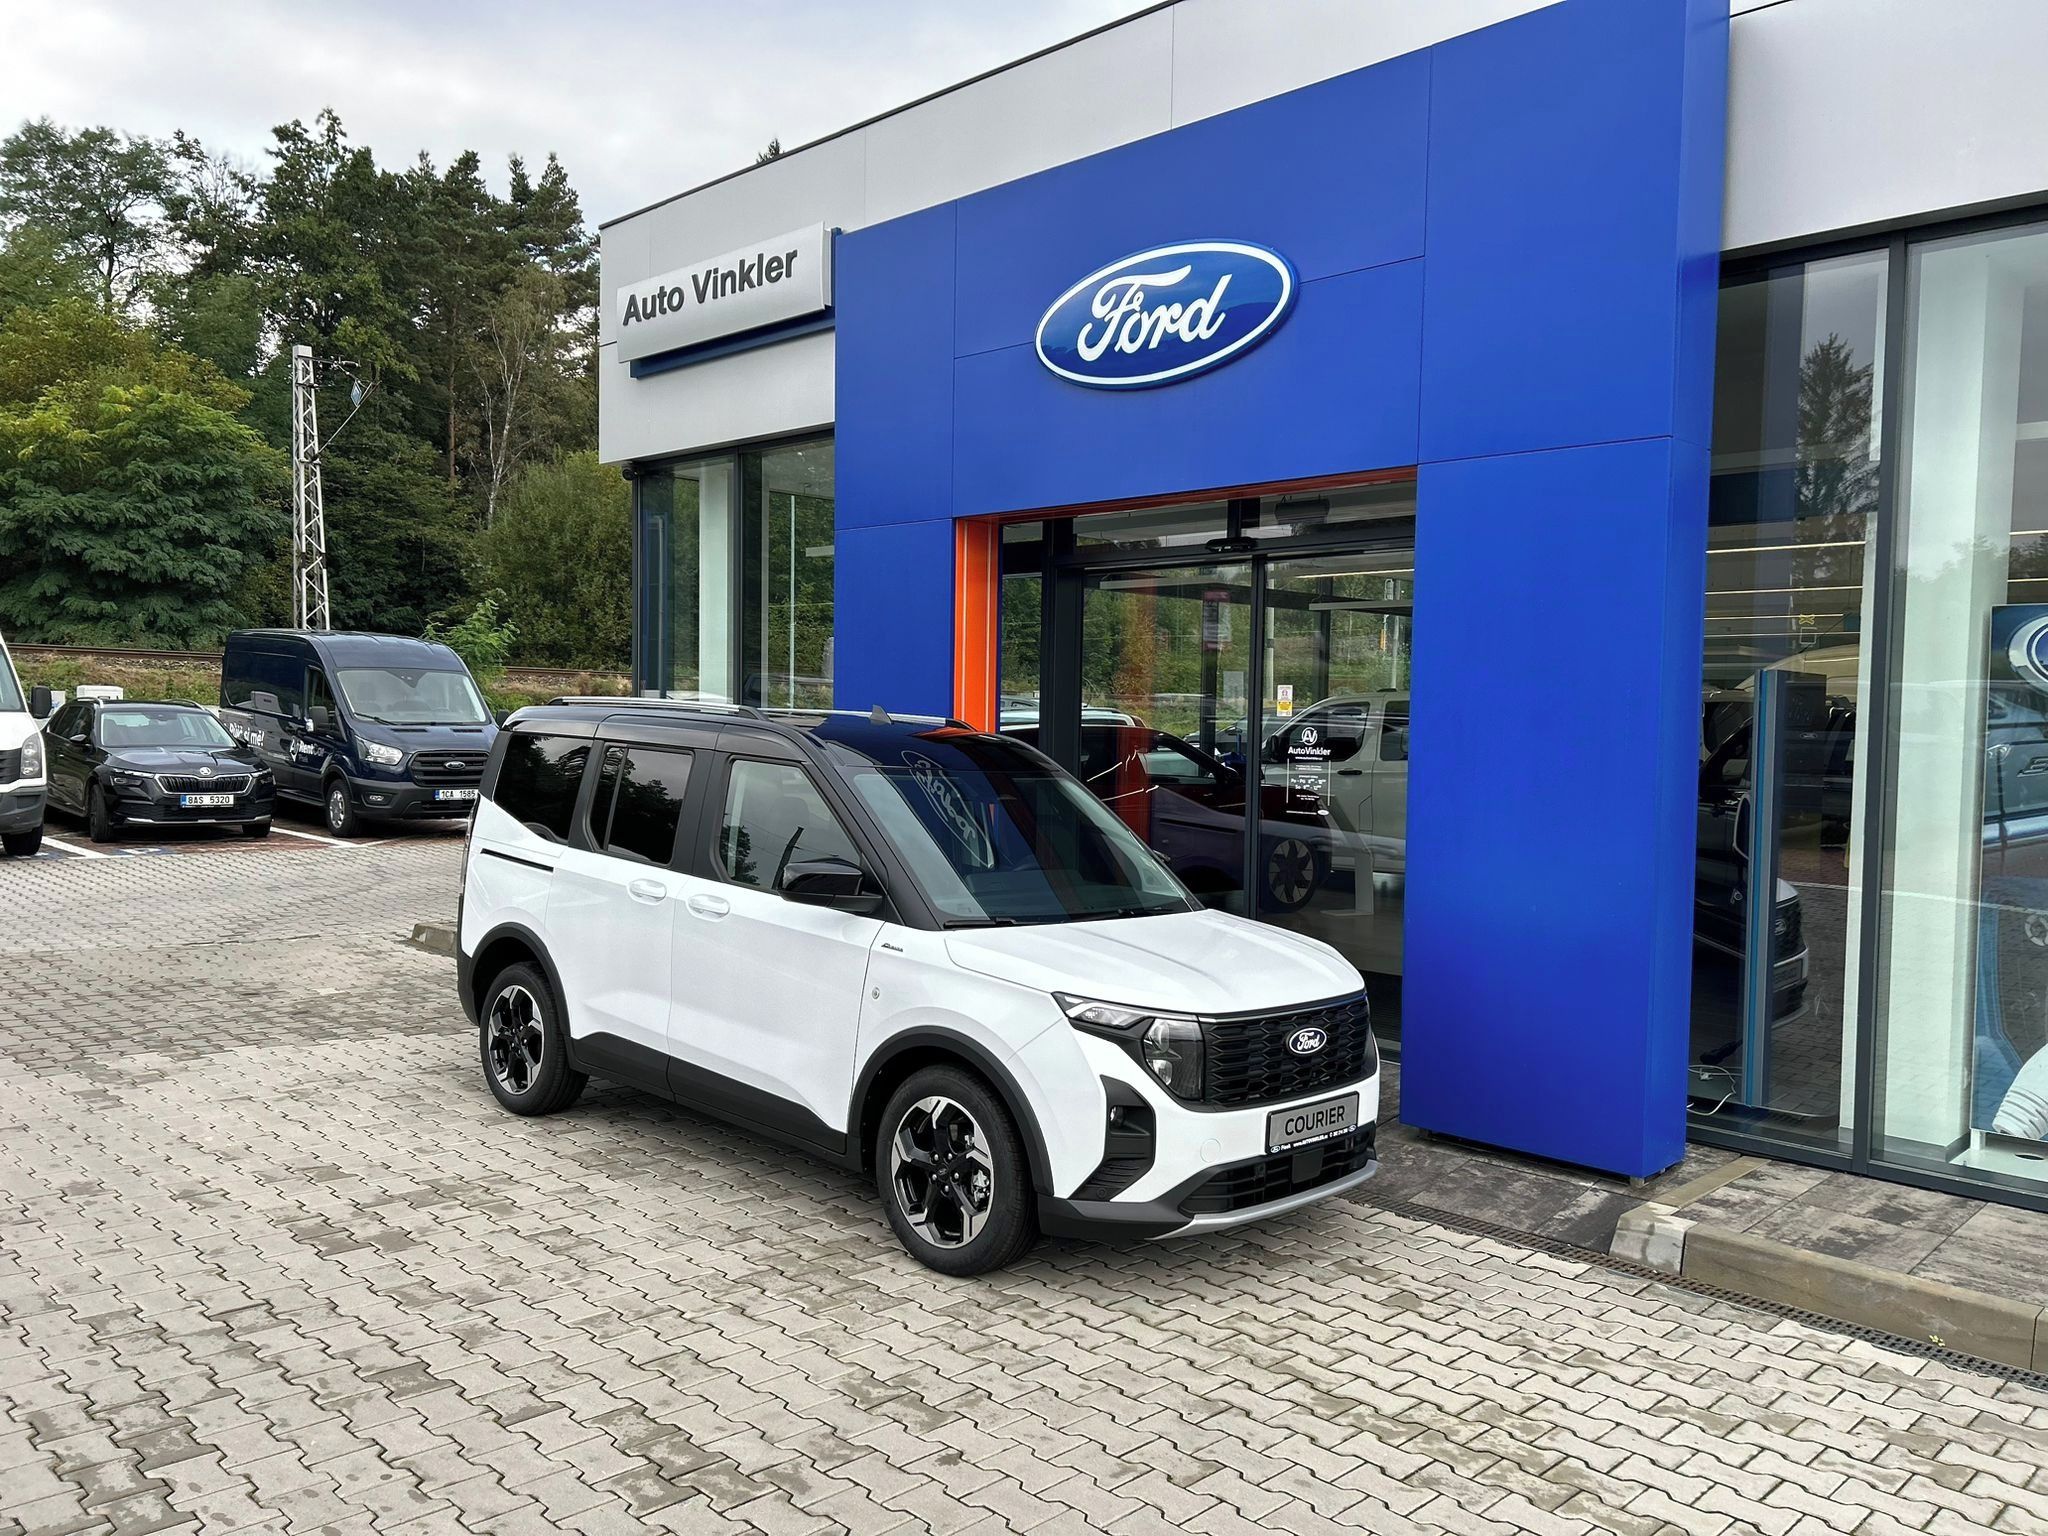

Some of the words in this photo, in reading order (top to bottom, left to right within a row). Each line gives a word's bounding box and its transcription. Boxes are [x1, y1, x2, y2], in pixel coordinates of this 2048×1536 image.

[623, 286, 685, 326] Auto
[692, 249, 798, 304] Vinkler
[1077, 265, 1233, 362] Ford
[1287, 746, 1331, 756] AutoVinkler
[188, 796, 204, 804] 8AS
[209, 796, 230, 804] 5320
[441, 790, 454, 798] 1CA
[1297, 1031, 1320, 1051] Ford
[1285, 1105, 1345, 1136] COURIER
